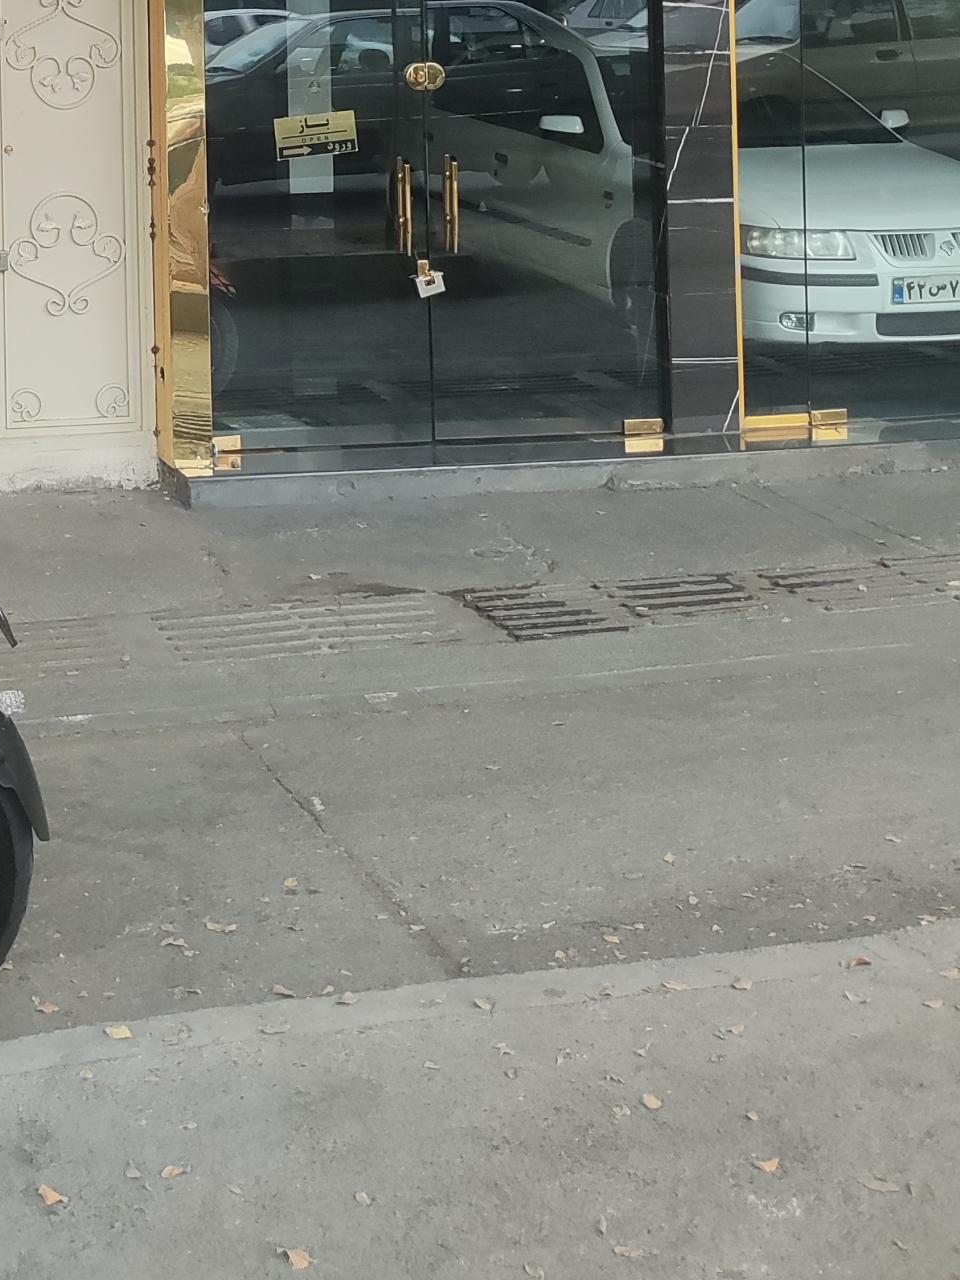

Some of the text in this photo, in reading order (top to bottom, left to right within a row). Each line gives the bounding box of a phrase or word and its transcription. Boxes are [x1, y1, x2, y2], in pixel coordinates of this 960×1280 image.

[298, 116, 330, 134] باز
[301, 135, 329, 144] OPEN
[327, 141, 352, 152] ورود
